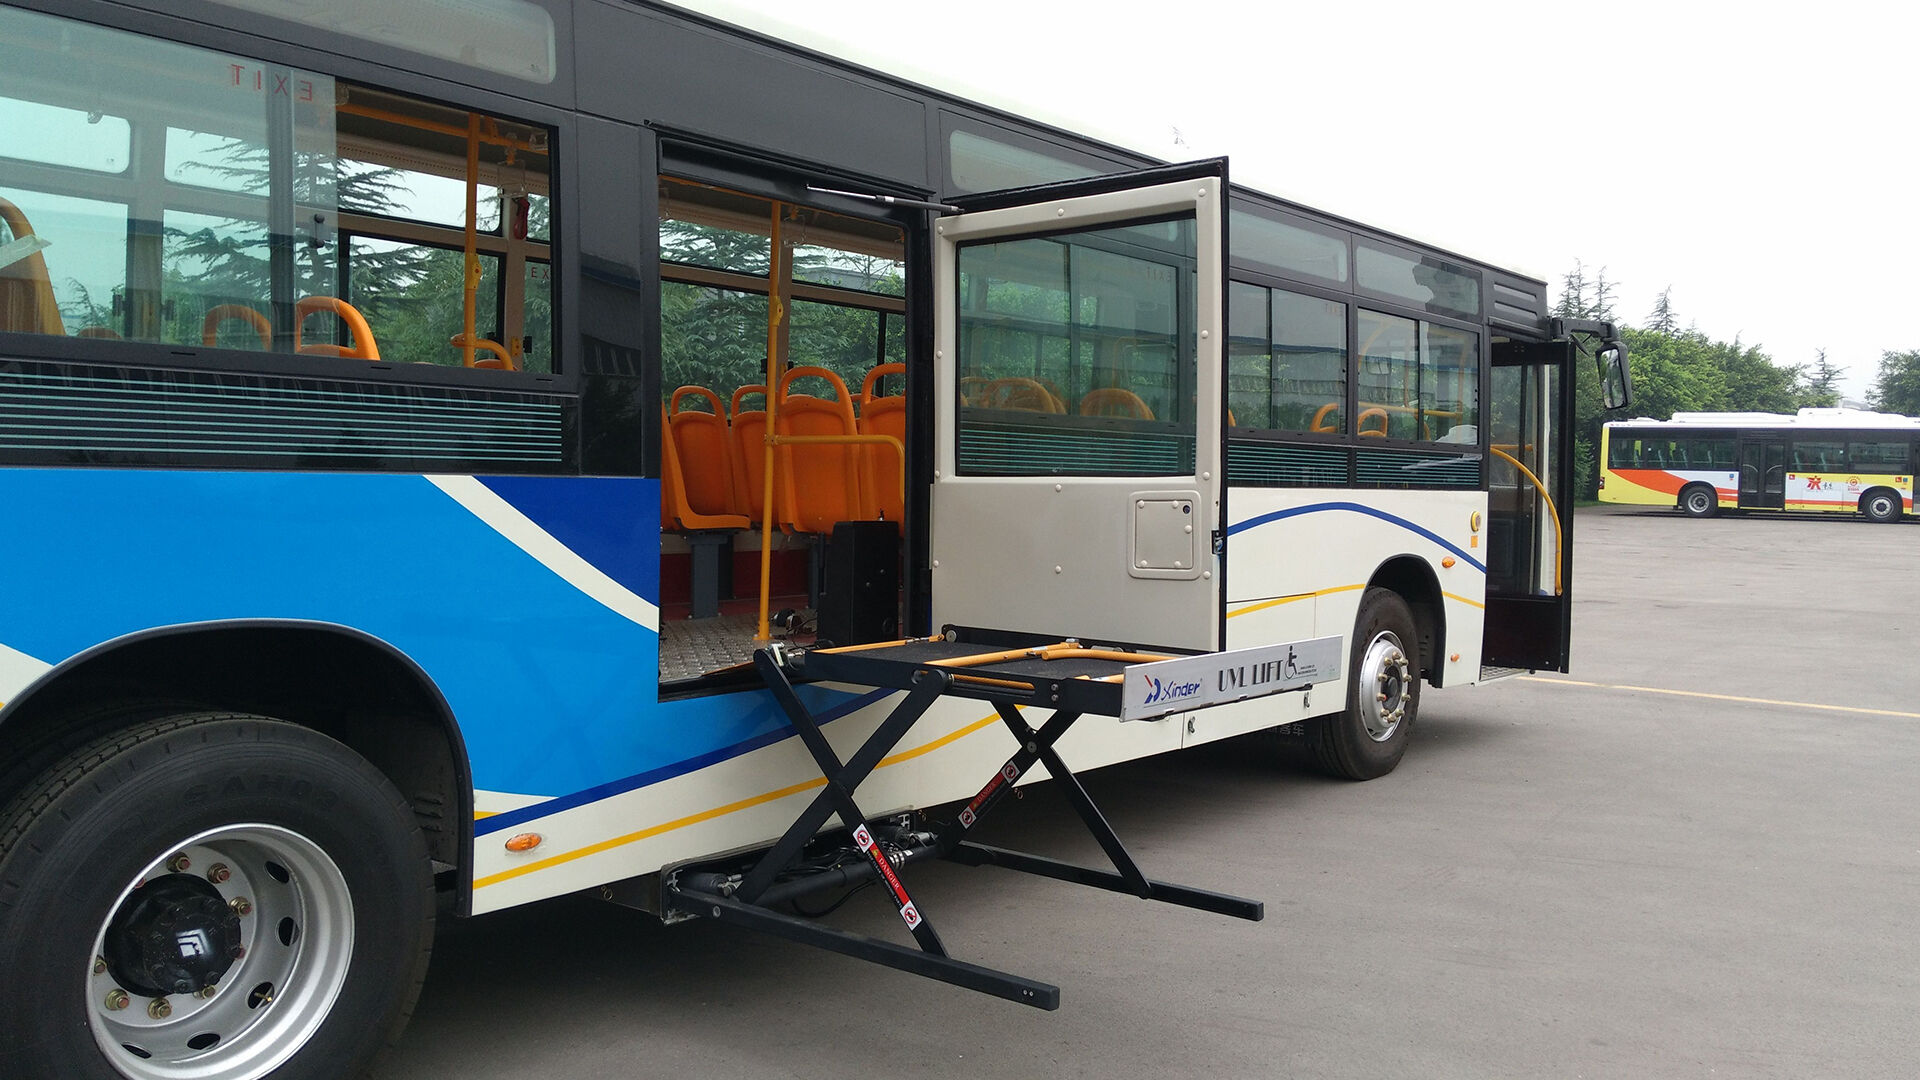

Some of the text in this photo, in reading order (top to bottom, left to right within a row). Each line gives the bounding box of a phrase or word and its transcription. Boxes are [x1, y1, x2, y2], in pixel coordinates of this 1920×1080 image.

[1218, 659, 1284, 692] UVL LIFT
[878, 857, 900, 890] DANGER
